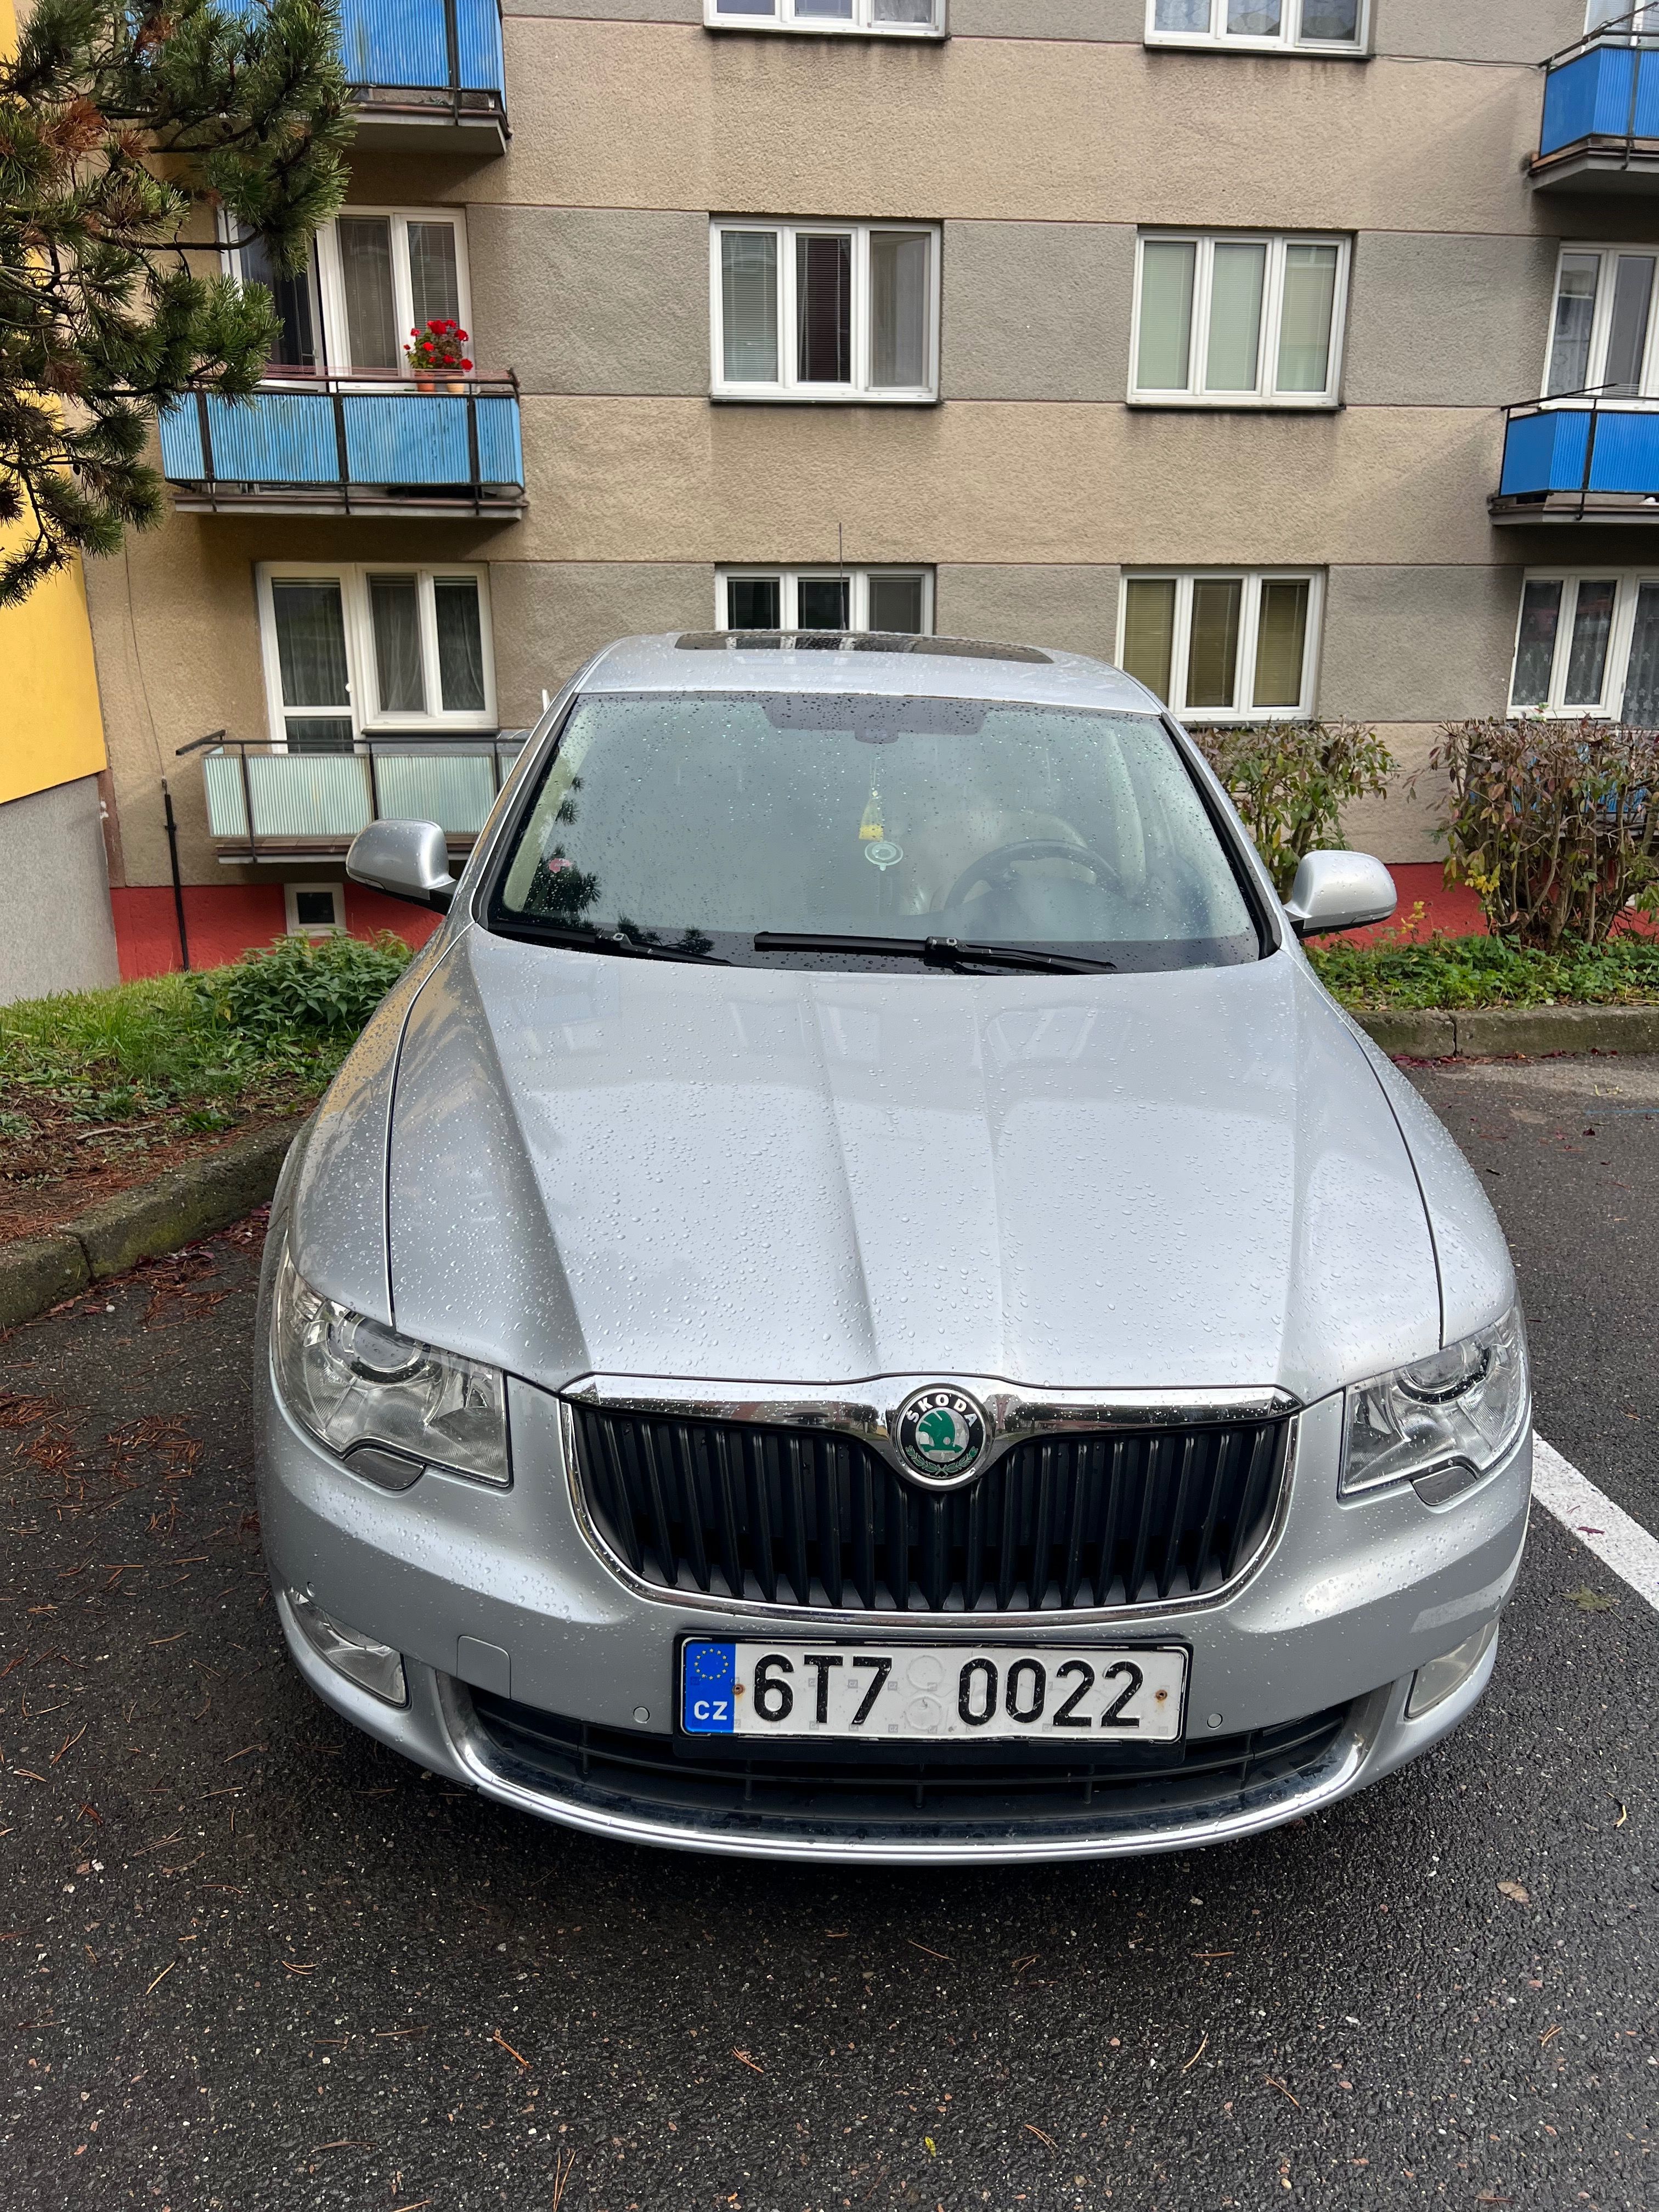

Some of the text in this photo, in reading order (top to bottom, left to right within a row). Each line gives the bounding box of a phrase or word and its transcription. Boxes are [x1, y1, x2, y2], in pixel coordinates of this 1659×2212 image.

[694, 1701, 727, 1720] CZ
[754, 1654, 1143, 1727] 6T7 0022
